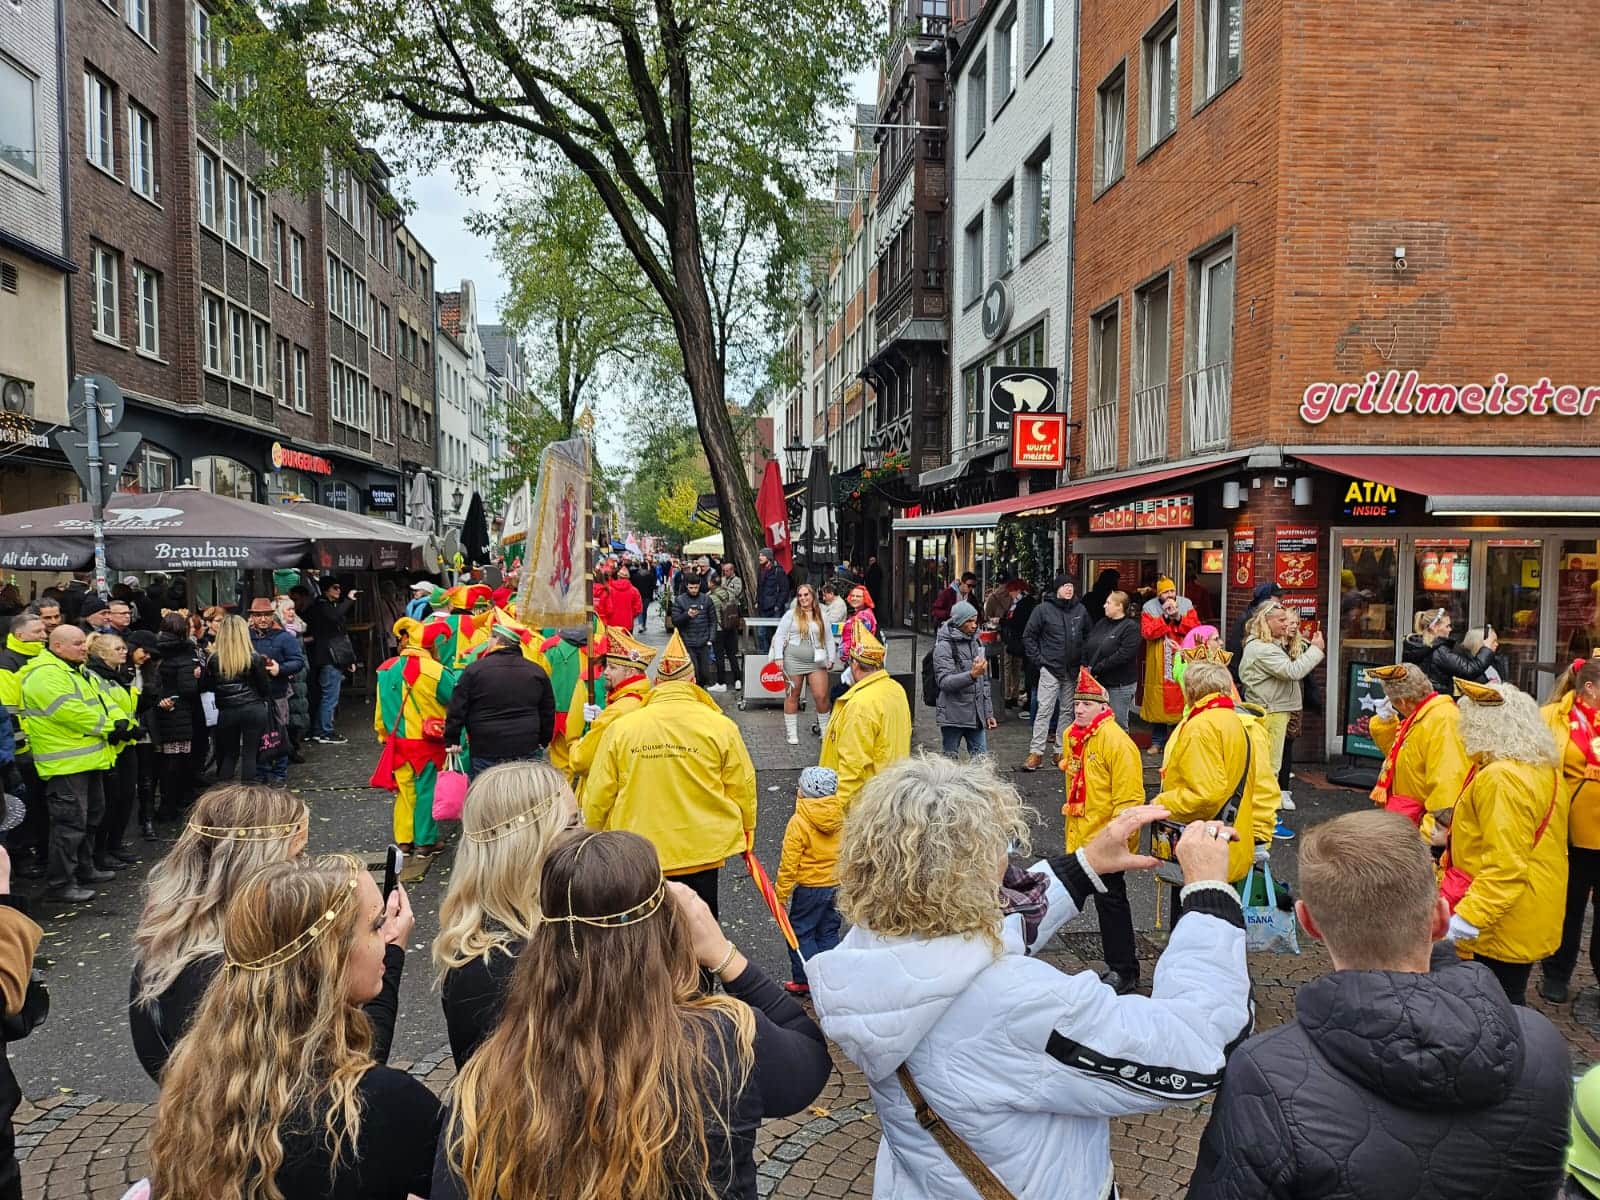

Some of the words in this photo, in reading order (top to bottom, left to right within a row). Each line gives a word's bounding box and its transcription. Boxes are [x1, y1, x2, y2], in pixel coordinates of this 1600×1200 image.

[1301, 370, 1600, 424] grillmeister
[1026, 443, 1052, 452] wurst
[281, 447, 313, 471] BURGER
[1023, 453, 1055, 461] meister
[1344, 481, 1397, 503] ATM
[1353, 506, 1387, 516] INSIDE
[155, 541, 249, 559] Brauhaus
[2, 552, 17, 565] Alt
[20, 552, 39, 566] der
[41, 553, 69, 567] Stadt
[1248, 915, 1273, 924] ISANA
